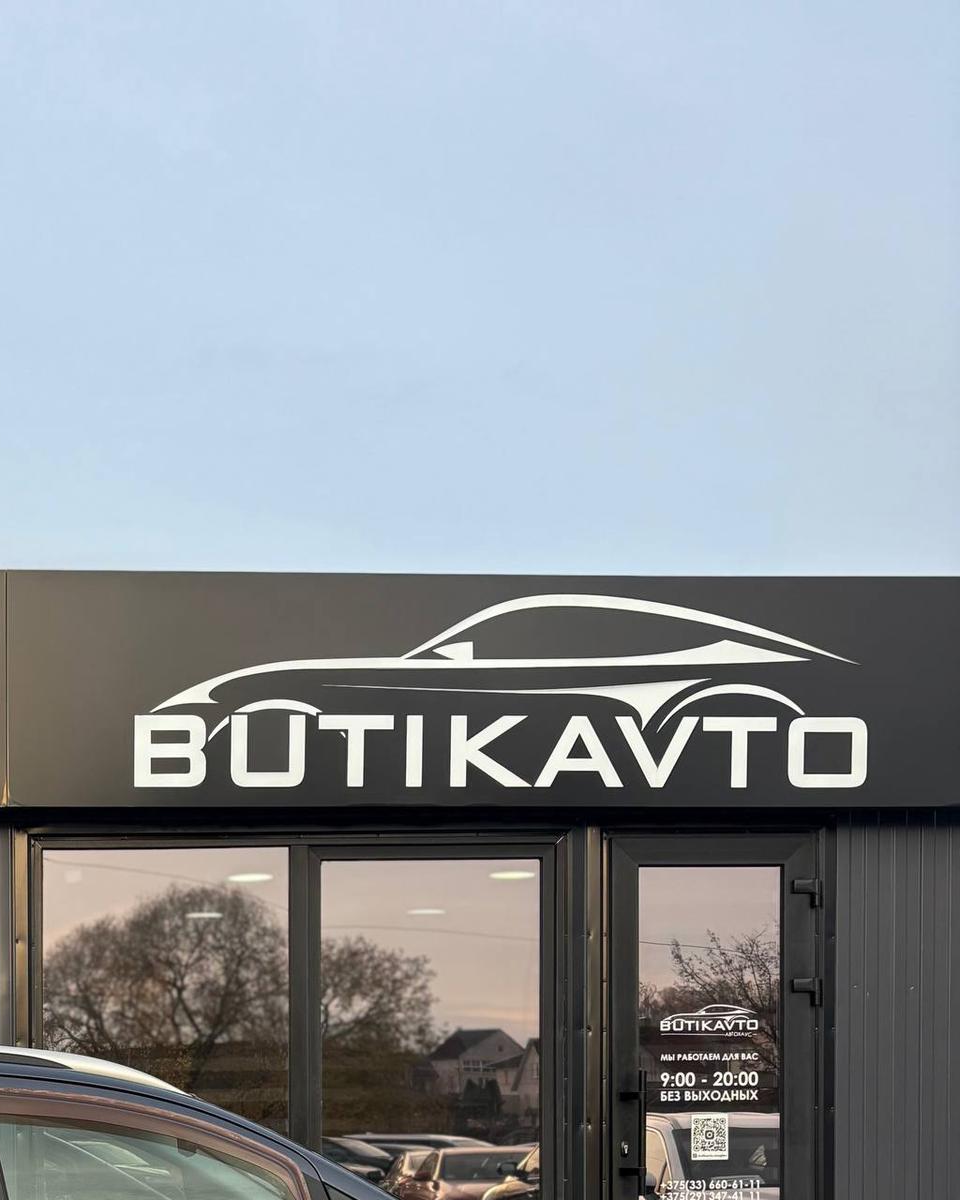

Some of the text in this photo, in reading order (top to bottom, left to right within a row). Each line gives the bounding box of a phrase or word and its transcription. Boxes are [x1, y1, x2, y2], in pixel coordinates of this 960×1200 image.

[133, 712, 868, 790] BUTIKAVTO
[659, 1020, 759, 1032] BUTIKAVTO
[660, 1052, 759, 1062] МЫ РАБОТАЕМ ДЛЯ ВАС
[660, 1072, 696, 1087] 9:00
[712, 1071, 759, 1087] 20:00
[660, 1089, 759, 1102] БЕЗ ВЫХОДНЫХ
[709, 1179, 760, 1190] 660-61-11
